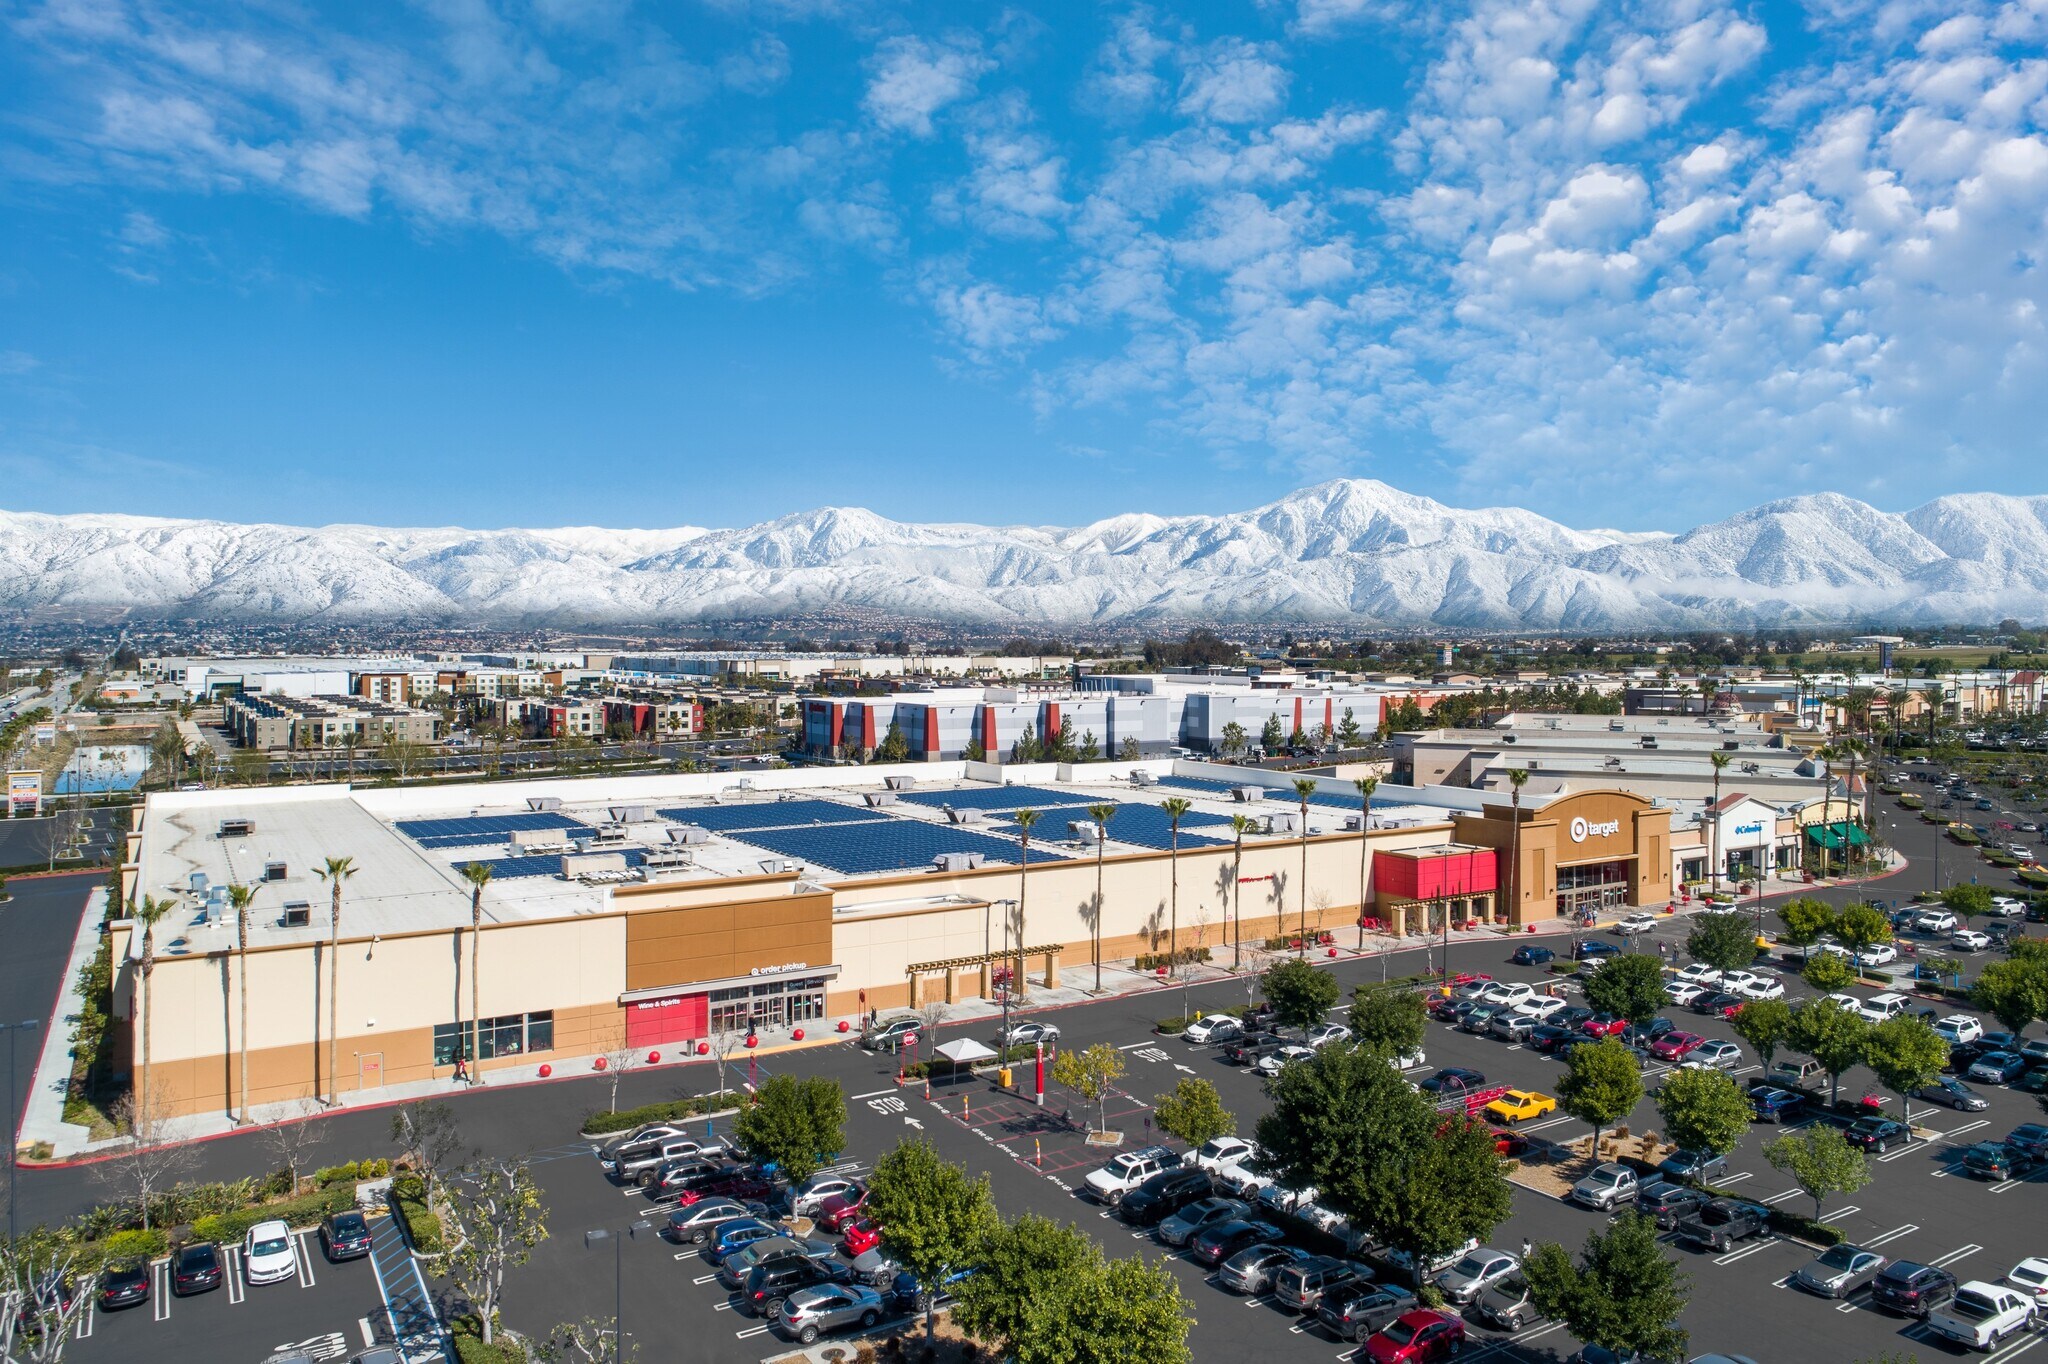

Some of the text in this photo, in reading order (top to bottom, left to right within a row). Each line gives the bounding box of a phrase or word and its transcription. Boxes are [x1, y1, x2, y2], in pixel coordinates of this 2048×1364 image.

[1588, 819, 1619, 837] target
[761, 962, 807, 974] order pickup
[638, 1002, 654, 1010] Wine
[660, 999, 681, 1007] Spirits
[1132, 1047, 1173, 1062] STOP
[867, 1096, 908, 1115] STOP
[1047, 1175, 1072, 1191] drive up
